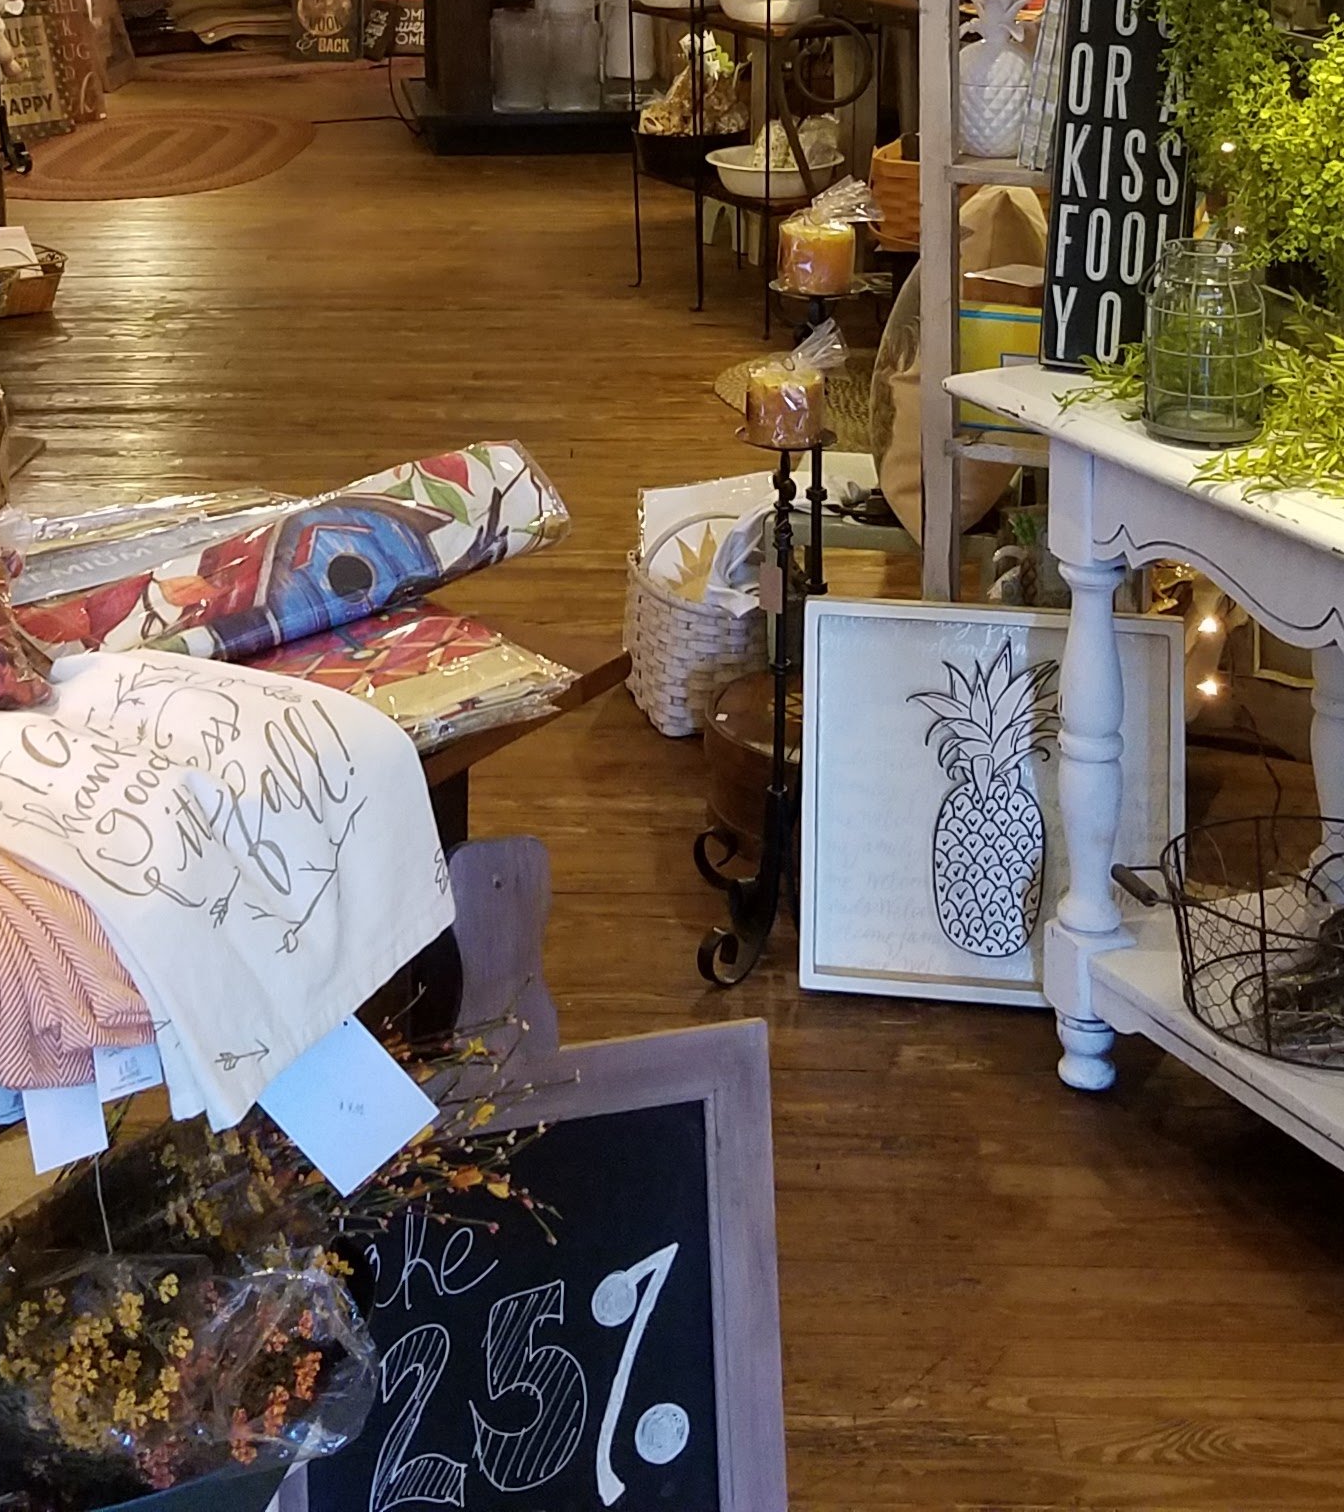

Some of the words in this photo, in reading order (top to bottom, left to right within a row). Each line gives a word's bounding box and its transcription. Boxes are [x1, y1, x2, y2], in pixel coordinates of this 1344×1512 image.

[318, 37, 350, 53] BACK
[1068, 44, 1133, 123] OR
[1060, 126, 1184, 204] KISS
[1053, 283, 1123, 365] YO
[3, 740, 138, 838] thank
[221, 698, 355, 896] fall!
[370, 1242, 691, 1510] 25%
